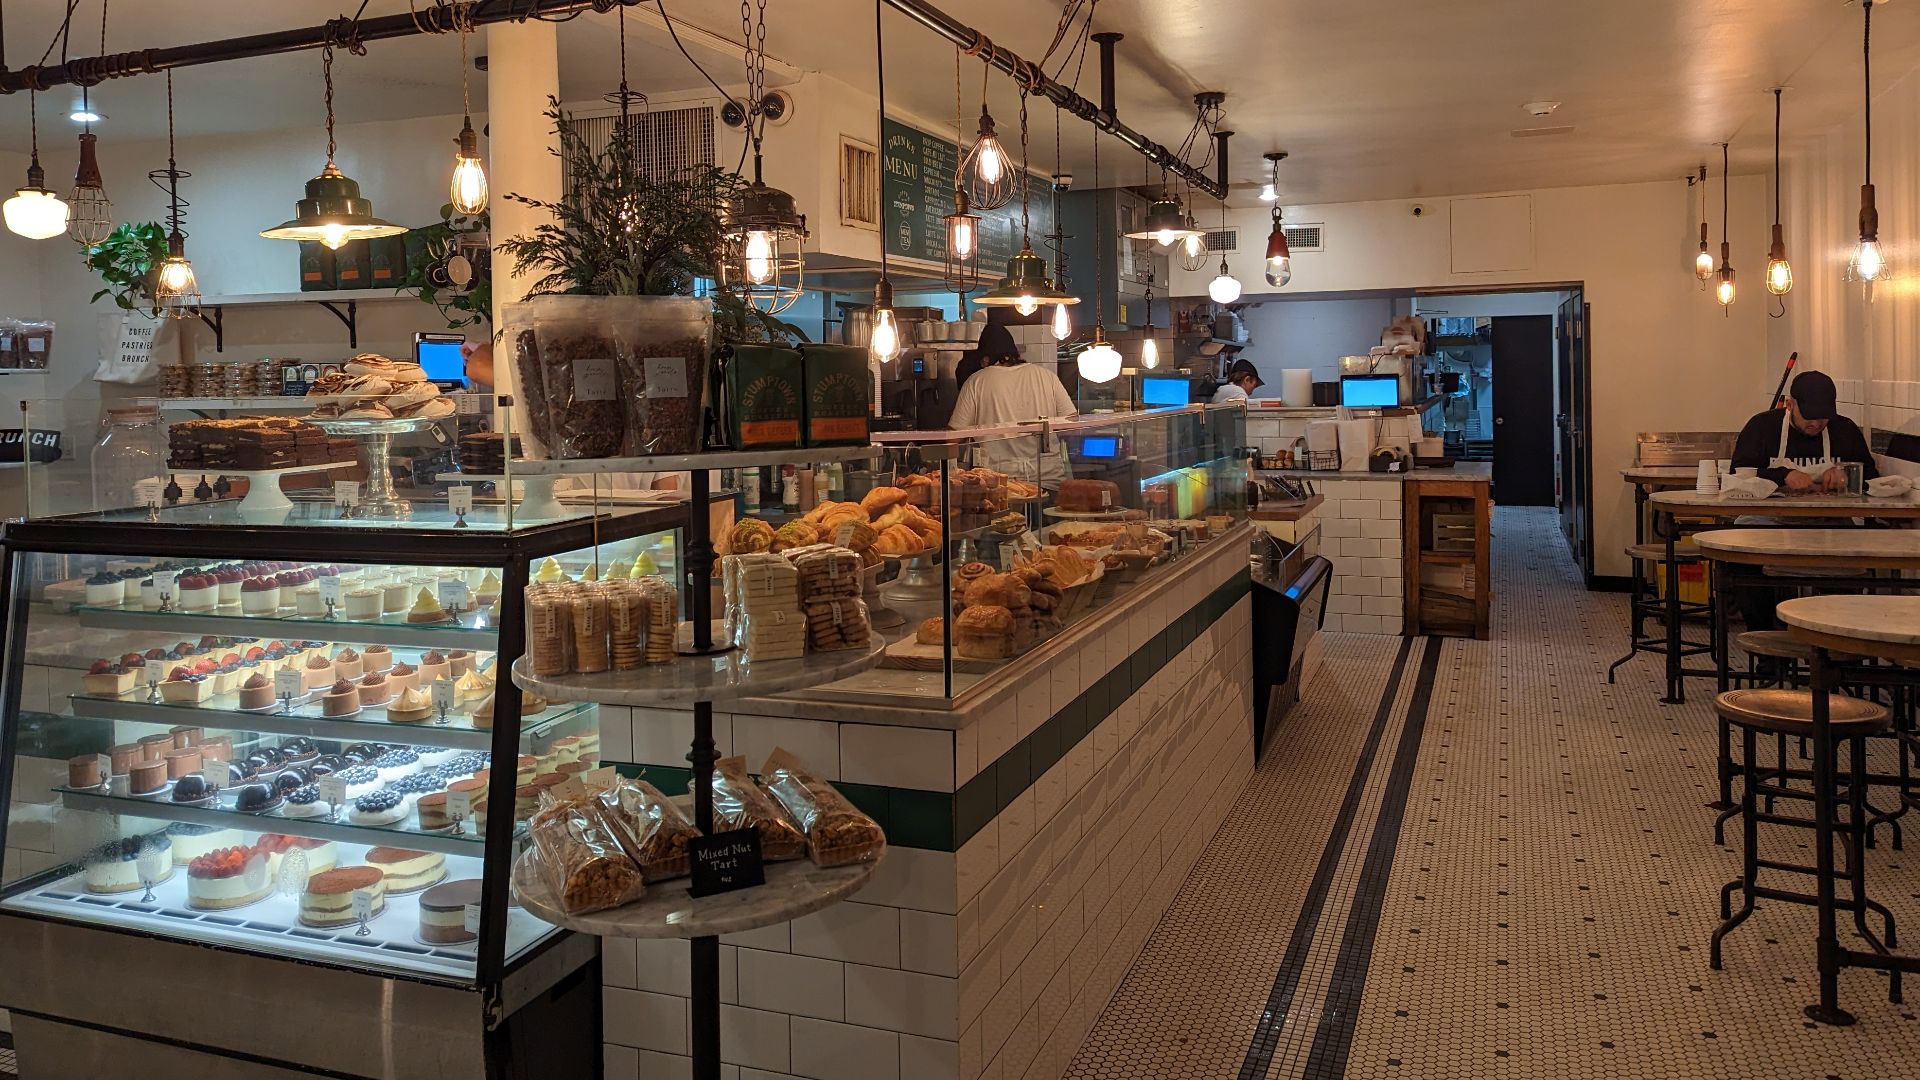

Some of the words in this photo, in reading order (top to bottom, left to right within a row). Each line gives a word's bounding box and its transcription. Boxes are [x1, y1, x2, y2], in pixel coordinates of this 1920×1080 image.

[888, 135, 915, 154] DRINKS
[885, 155, 918, 180] MENU
[128, 327, 152, 336] COFFEE
[121, 341, 153, 350] PASTRIES
[121, 354, 150, 363] BRUNCH
[742, 375, 797, 407] STUMPTOWN
[812, 373, 866, 403] STUMPTOWN
[697, 846, 729, 862] Mixed
[731, 843, 752, 855] Nut
[710, 857, 738, 871] Tart
